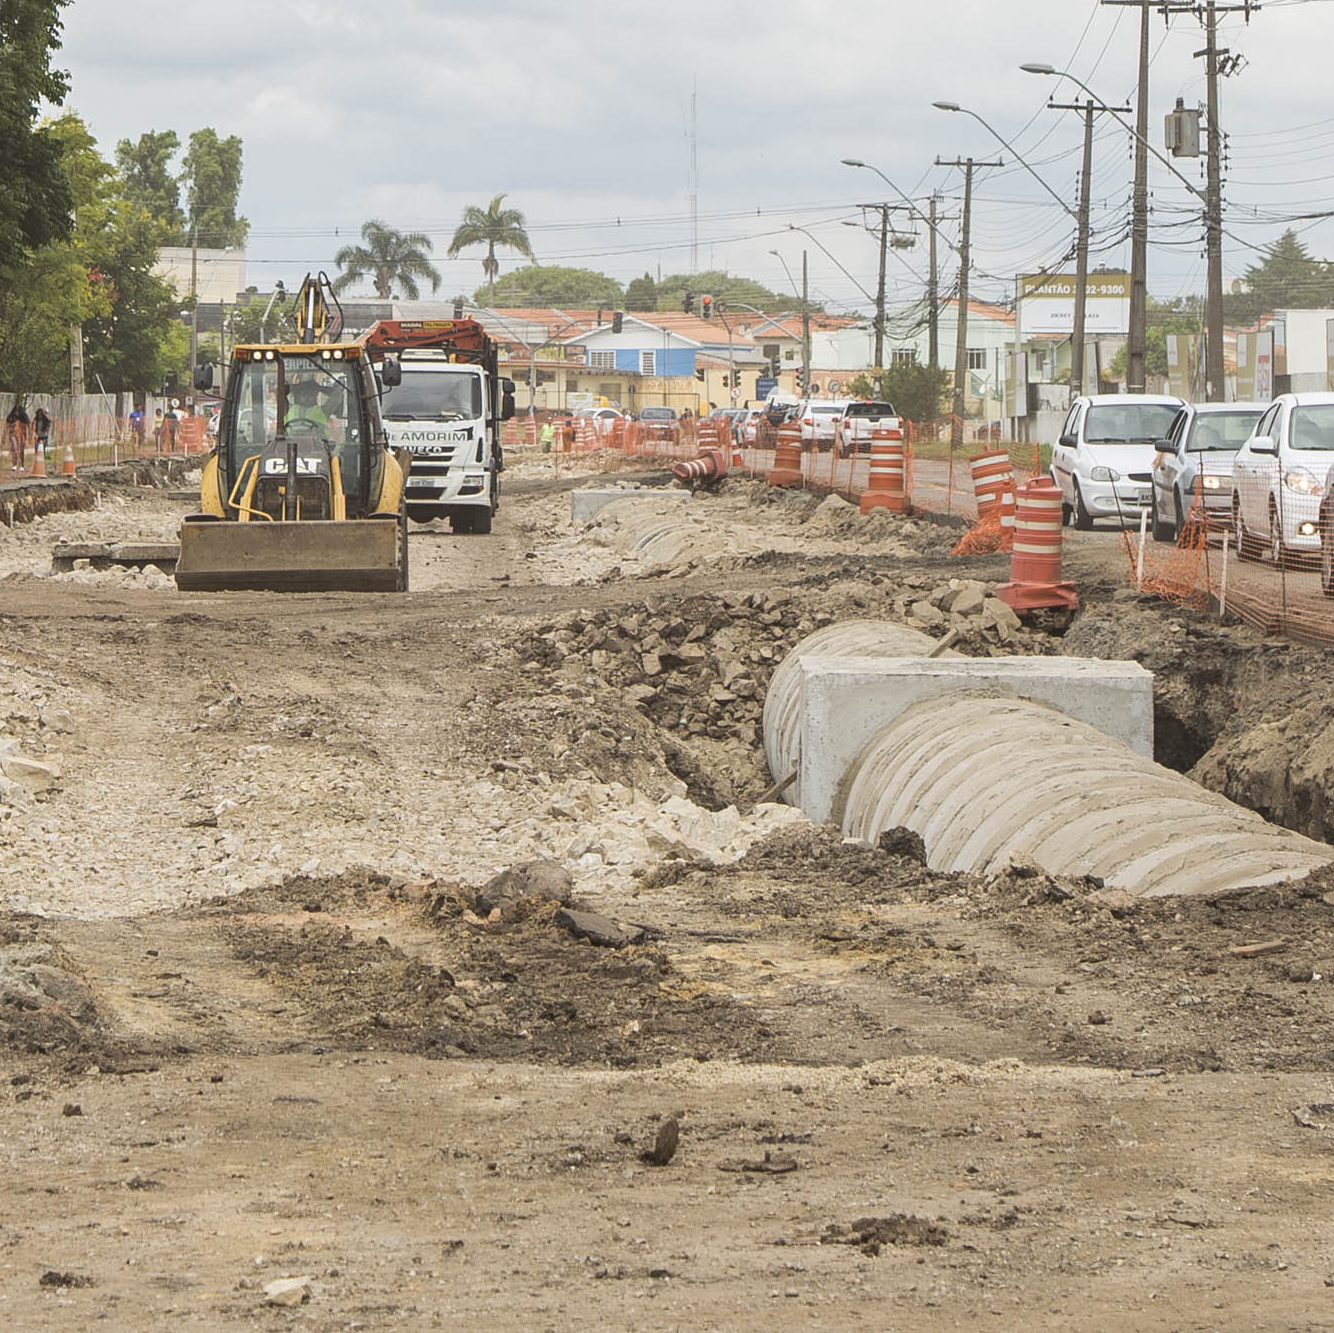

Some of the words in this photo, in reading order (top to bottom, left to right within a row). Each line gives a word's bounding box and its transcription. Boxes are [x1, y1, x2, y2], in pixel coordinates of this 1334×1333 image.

[1073, 285, 1124, 294] 02-9300
[400, 432, 466, 441] AMORIM
[403, 446, 442, 455] IVECO
[265, 457, 323, 474] CAT
